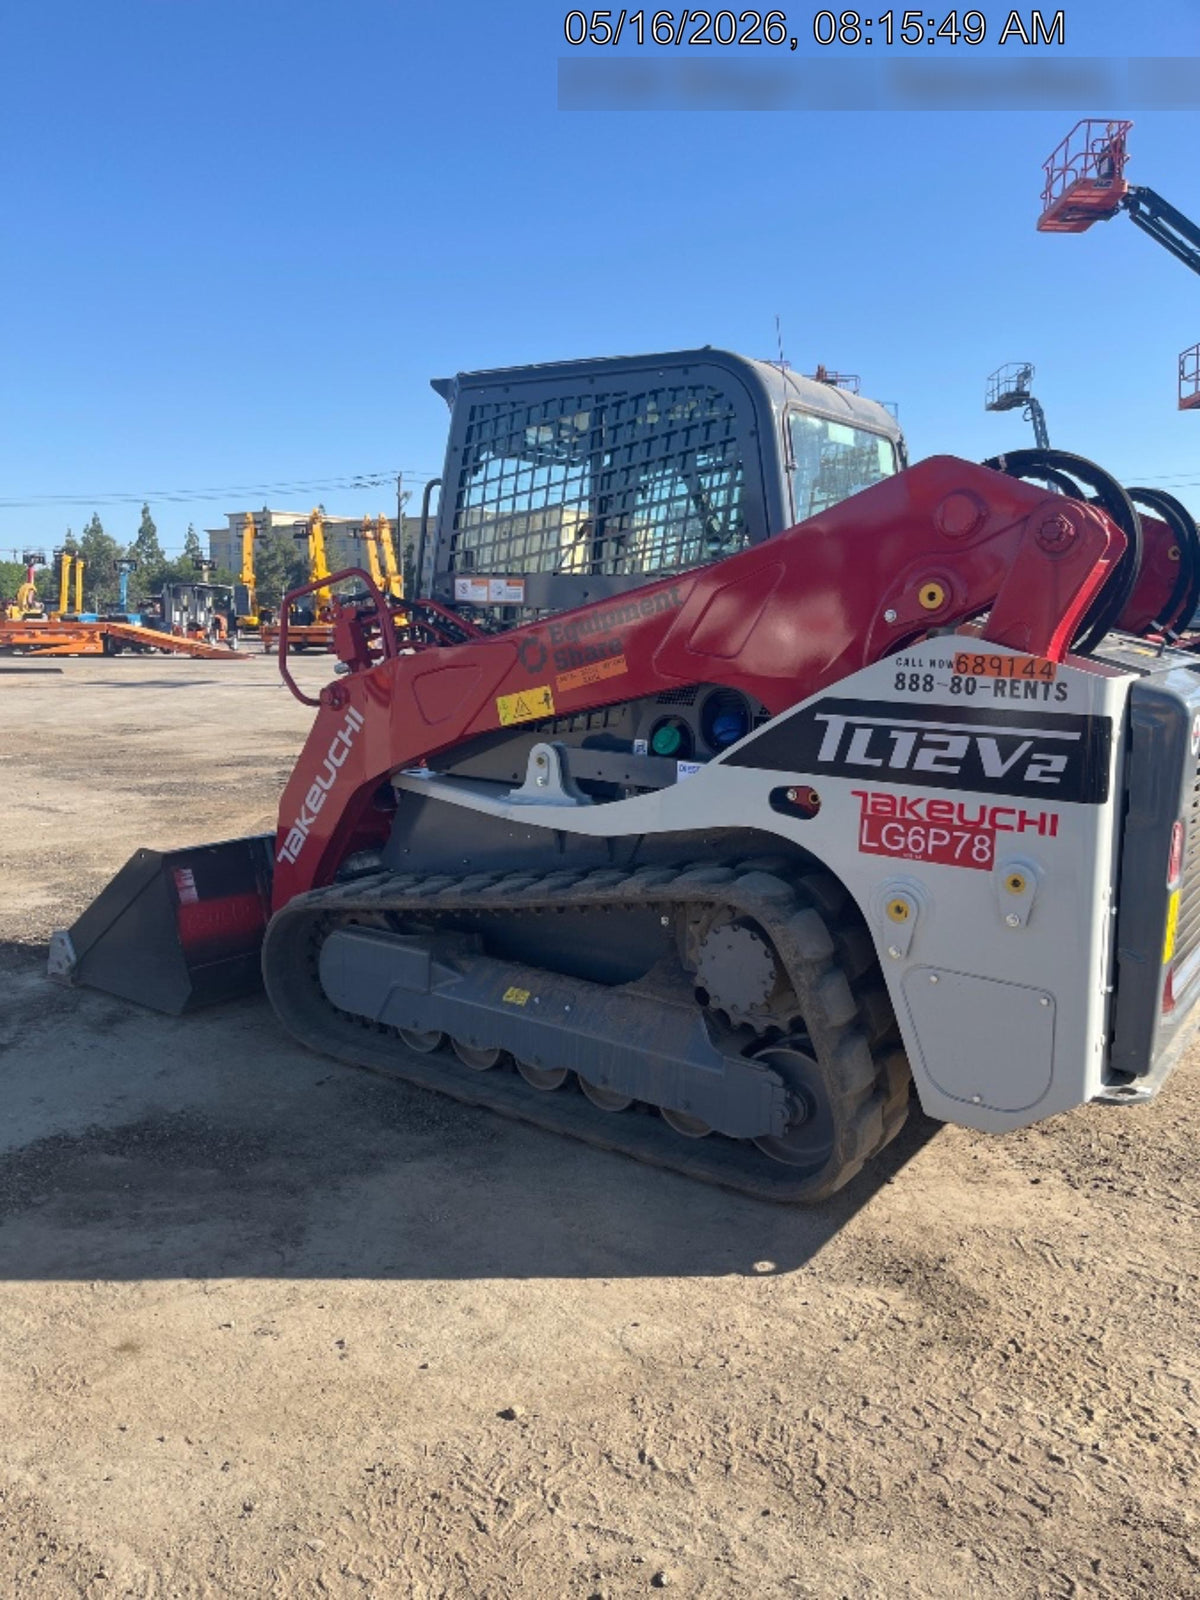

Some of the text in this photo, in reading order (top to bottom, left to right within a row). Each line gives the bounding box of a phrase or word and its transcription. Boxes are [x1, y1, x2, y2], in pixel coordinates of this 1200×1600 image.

[546, 586, 682, 645] Equipment
[553, 638, 624, 672] Share
[895, 657, 954, 669] CALL NOW
[955, 654, 1055, 679] 689144
[894, 671, 1069, 702] 888-80-RENTS
[814, 712, 1082, 785] TL12V2
[861, 818, 992, 863] LG6P78
